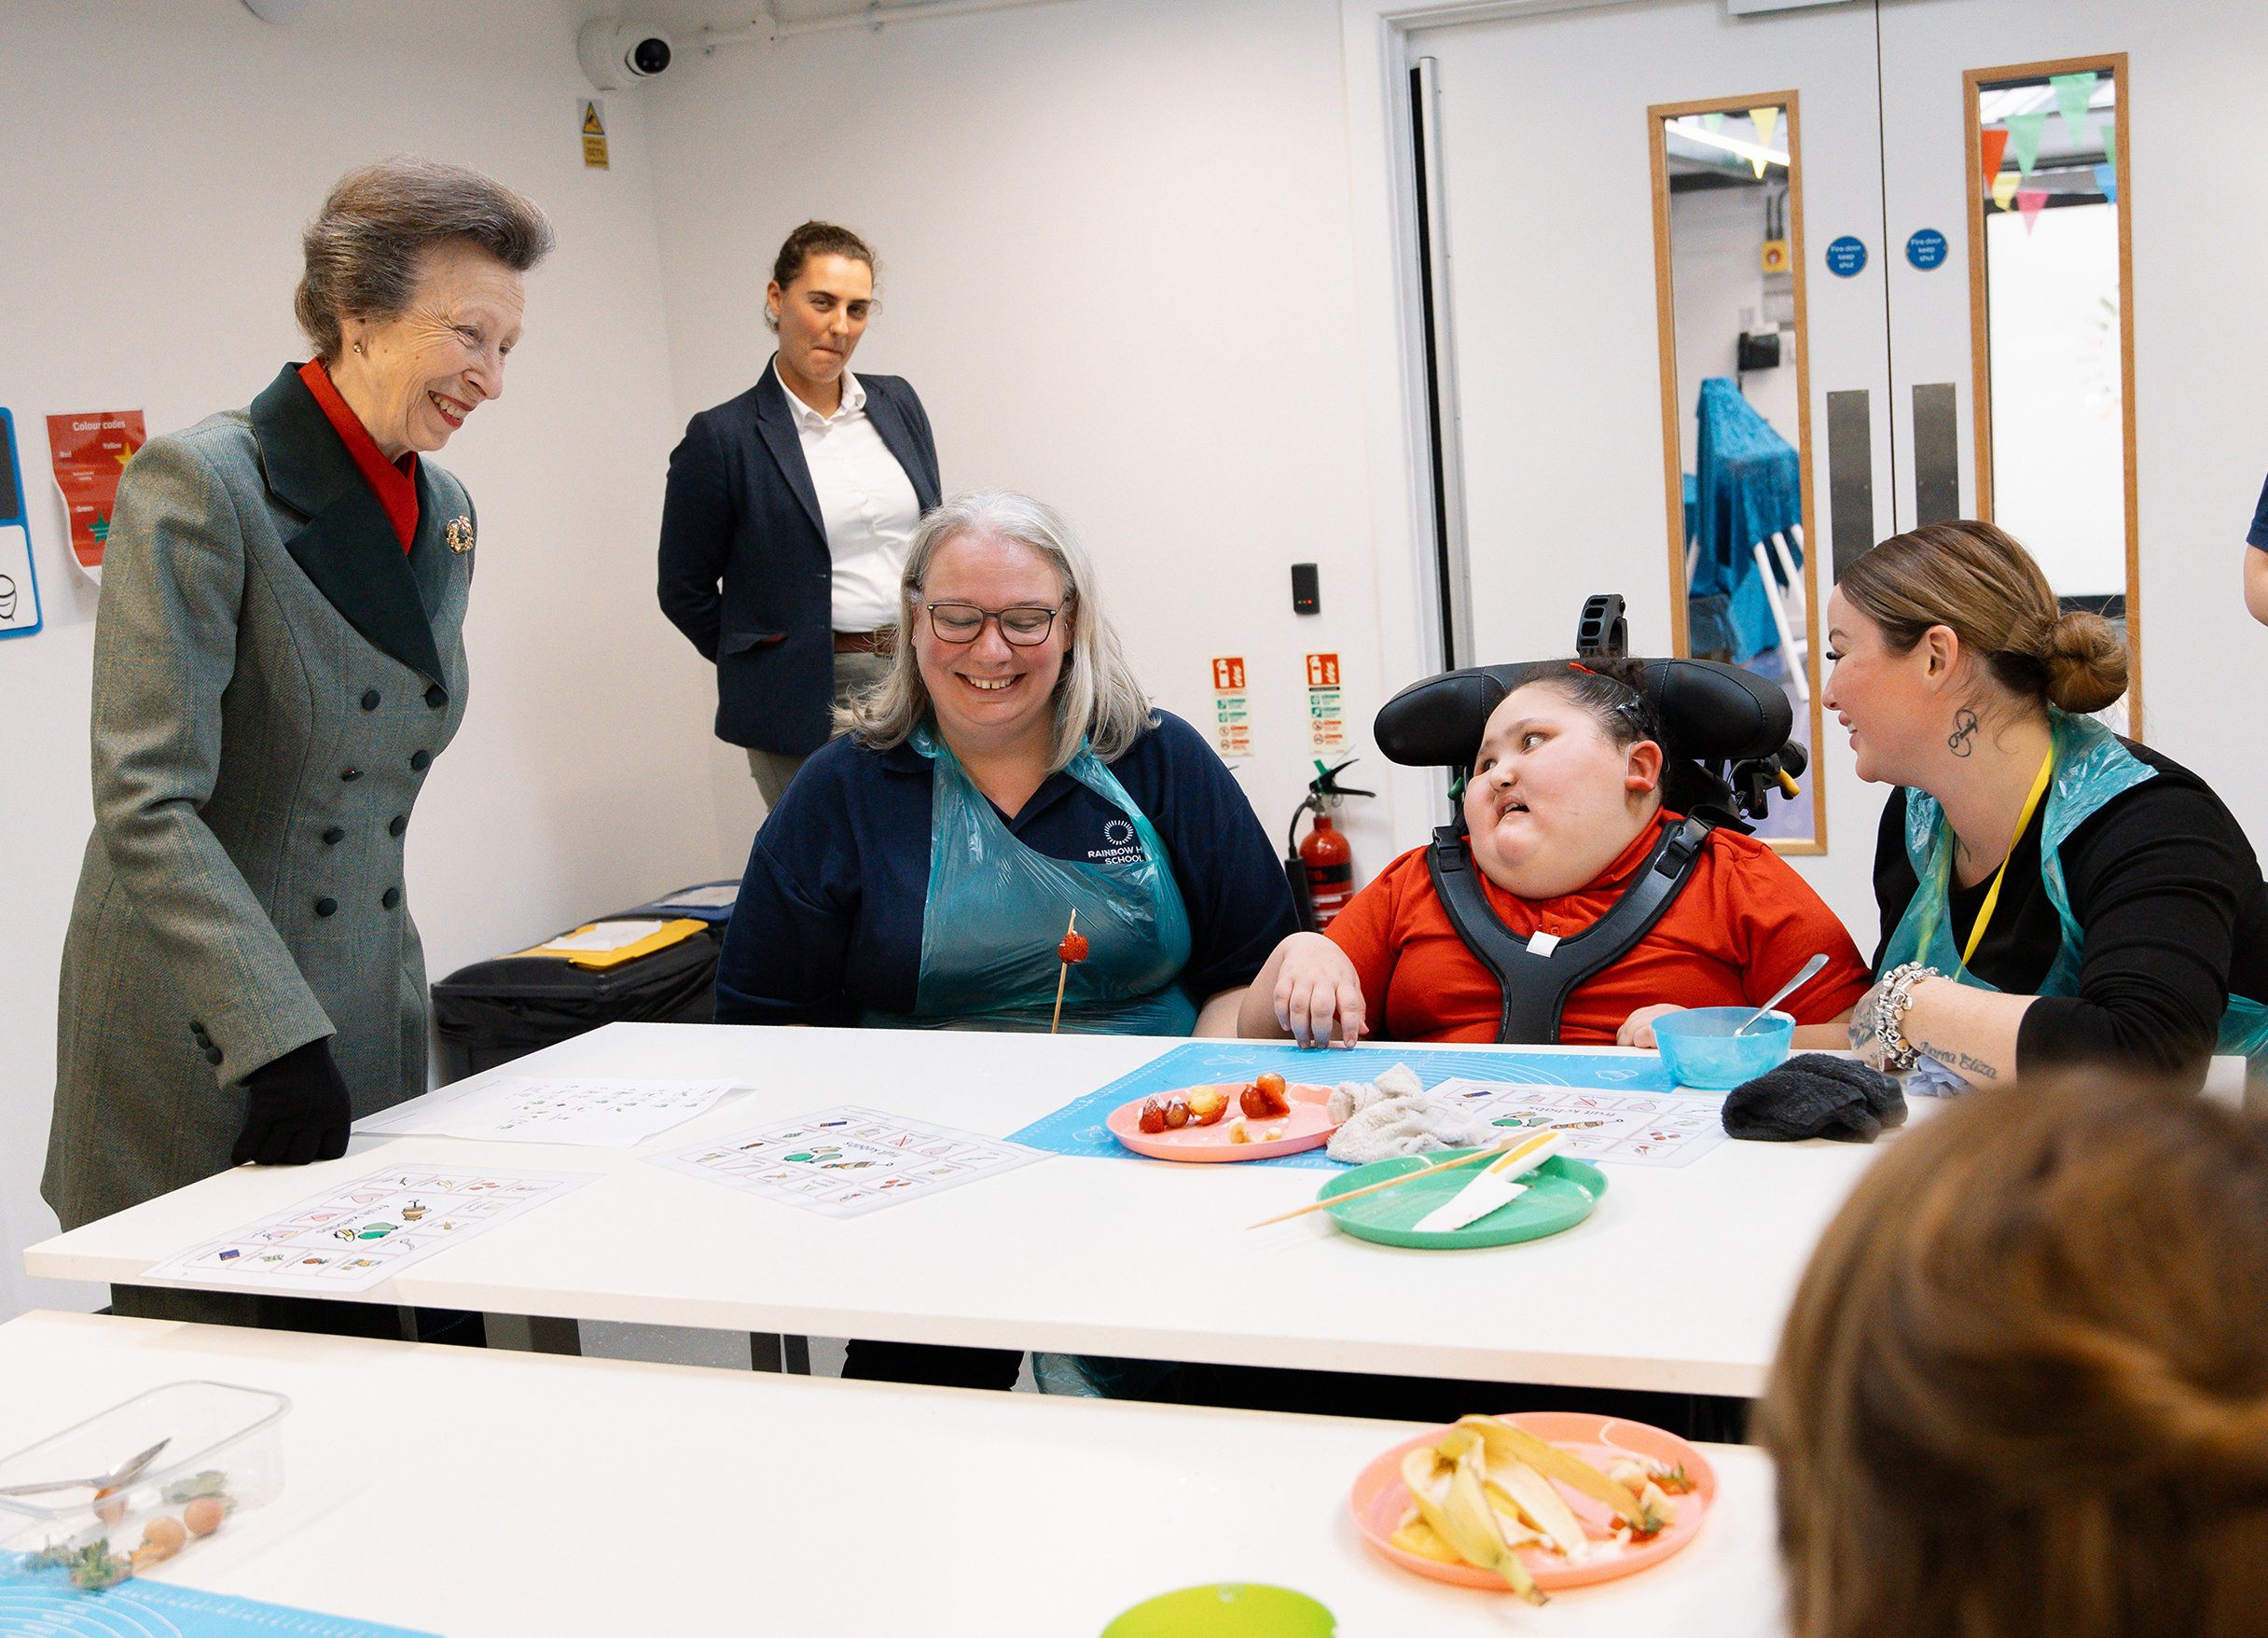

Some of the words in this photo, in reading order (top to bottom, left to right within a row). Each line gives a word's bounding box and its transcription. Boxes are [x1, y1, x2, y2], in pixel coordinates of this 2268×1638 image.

[73, 421, 102, 431] Colour
[103, 420, 126, 430] codes
[1087, 846, 1134, 858] RAINBOW
[1104, 854, 1144, 866] SCHOOL
